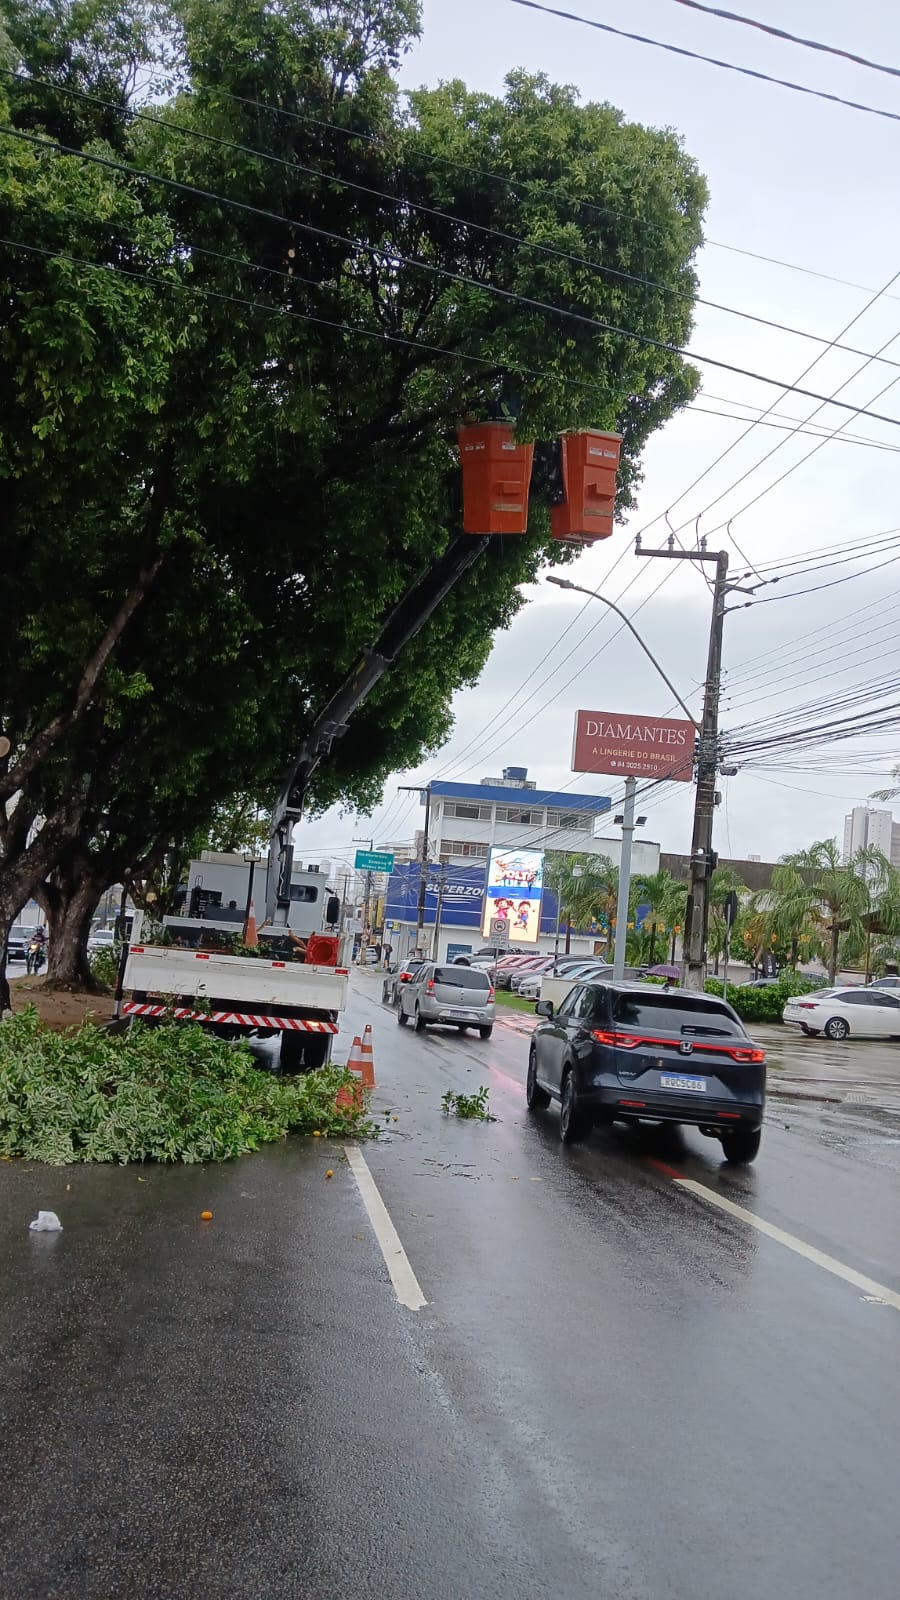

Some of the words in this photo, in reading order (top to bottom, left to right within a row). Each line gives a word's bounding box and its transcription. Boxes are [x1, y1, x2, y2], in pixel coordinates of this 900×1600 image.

[586, 721, 686, 744] DIAMANTES
[599, 748, 635, 758] LINGERIE
[636, 751, 648, 759] DO
[650, 753, 677, 762] BRASIL
[425, 883, 485, 896] SUPERZO
